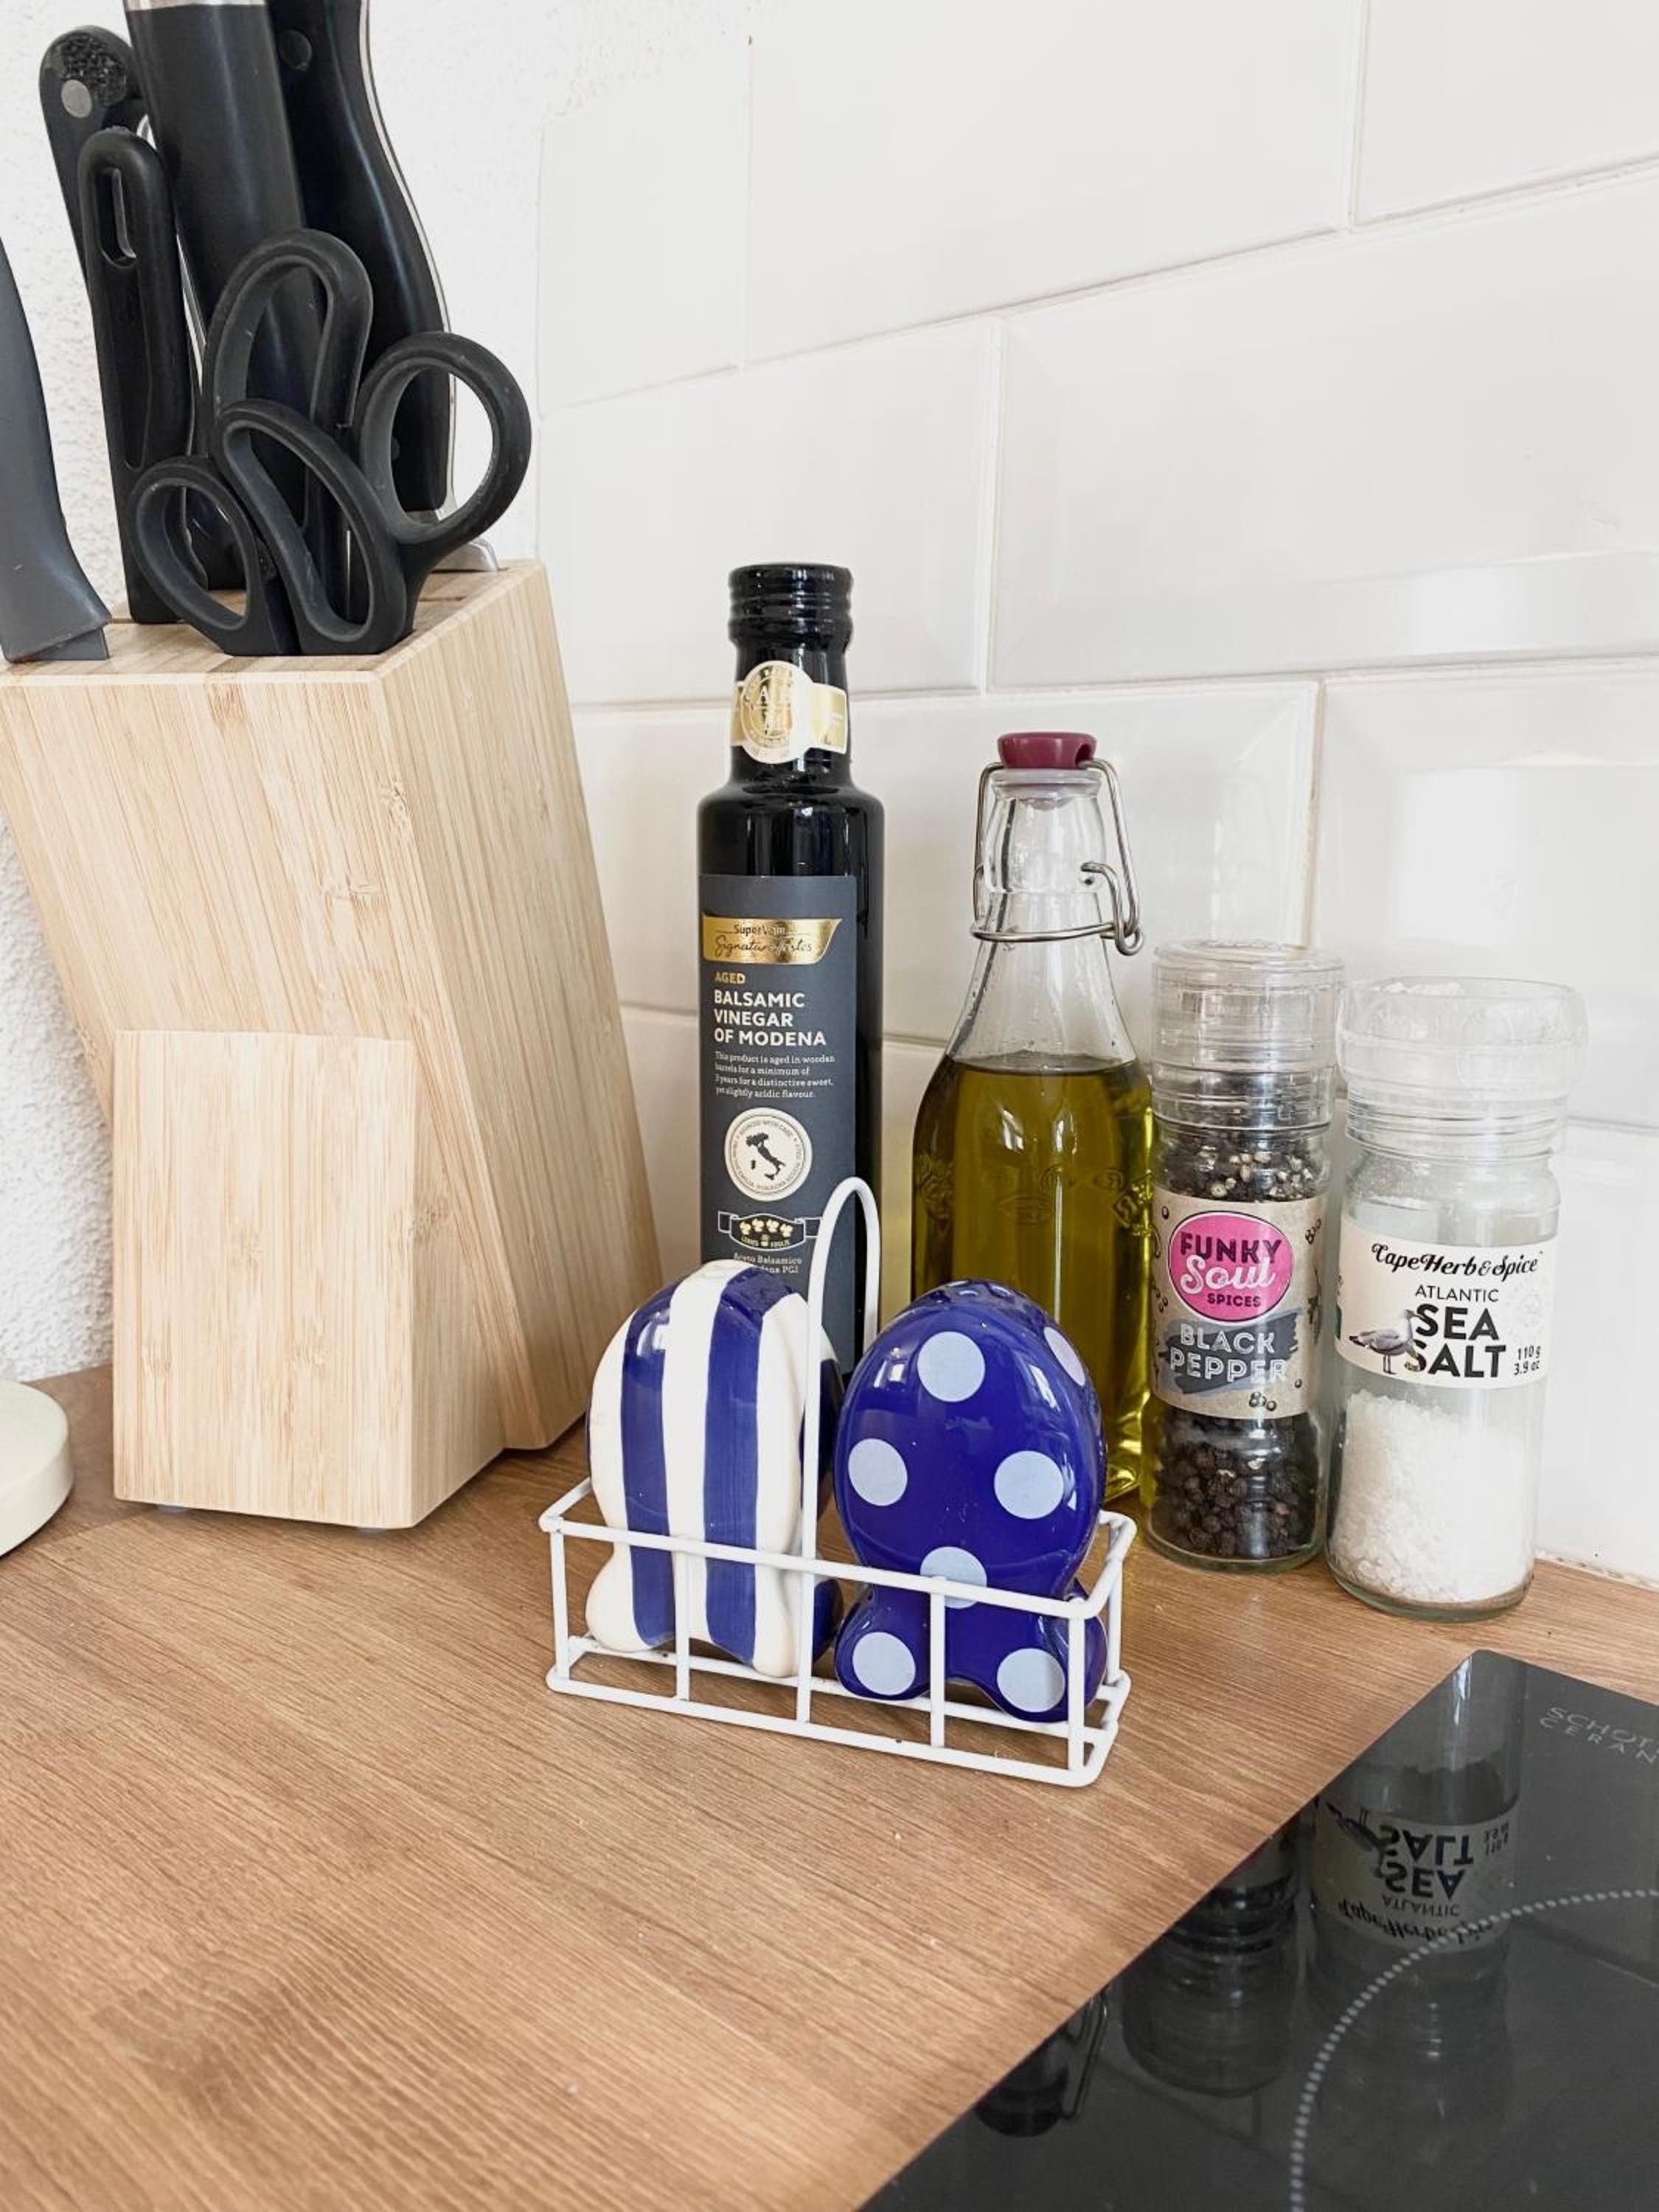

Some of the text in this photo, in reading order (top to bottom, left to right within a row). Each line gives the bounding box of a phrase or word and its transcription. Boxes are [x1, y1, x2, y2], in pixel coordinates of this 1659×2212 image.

[714, 972, 745, 984] AGED
[714, 990, 805, 1008] BALSAMIC
[714, 1009, 793, 1027] VINEGAR
[714, 1028, 826, 1046] OF MODENA
[729, 1053, 759, 1063] product
[769, 1055, 790, 1065] aged
[791, 1055, 801, 1063] in
[757, 1067, 800, 1075] minimum
[801, 1066, 810, 1075] of
[757, 1077, 806, 1087] distinctive
[754, 1089, 780, 1098] acidic
[1180, 1231, 1282, 1264] FUNKY
[757, 1255, 802, 1265] Balsamico
[1180, 1254, 1276, 1294] Soul
[1207, 1293, 1262, 1307] SPICES
[1415, 1284, 1499, 1303] ATLANTIC
[1416, 1303, 1500, 1340] SEA
[1180, 1324, 1275, 1354] BLACK
[1170, 1348, 1287, 1383] PEPPER
[1405, 1339, 1506, 1378] SALT
[1514, 1360, 1528, 1376] 3.9
[1548, 1707, 1659, 1754] SCHOT
[1540, 1717, 1657, 1763] CERAN
